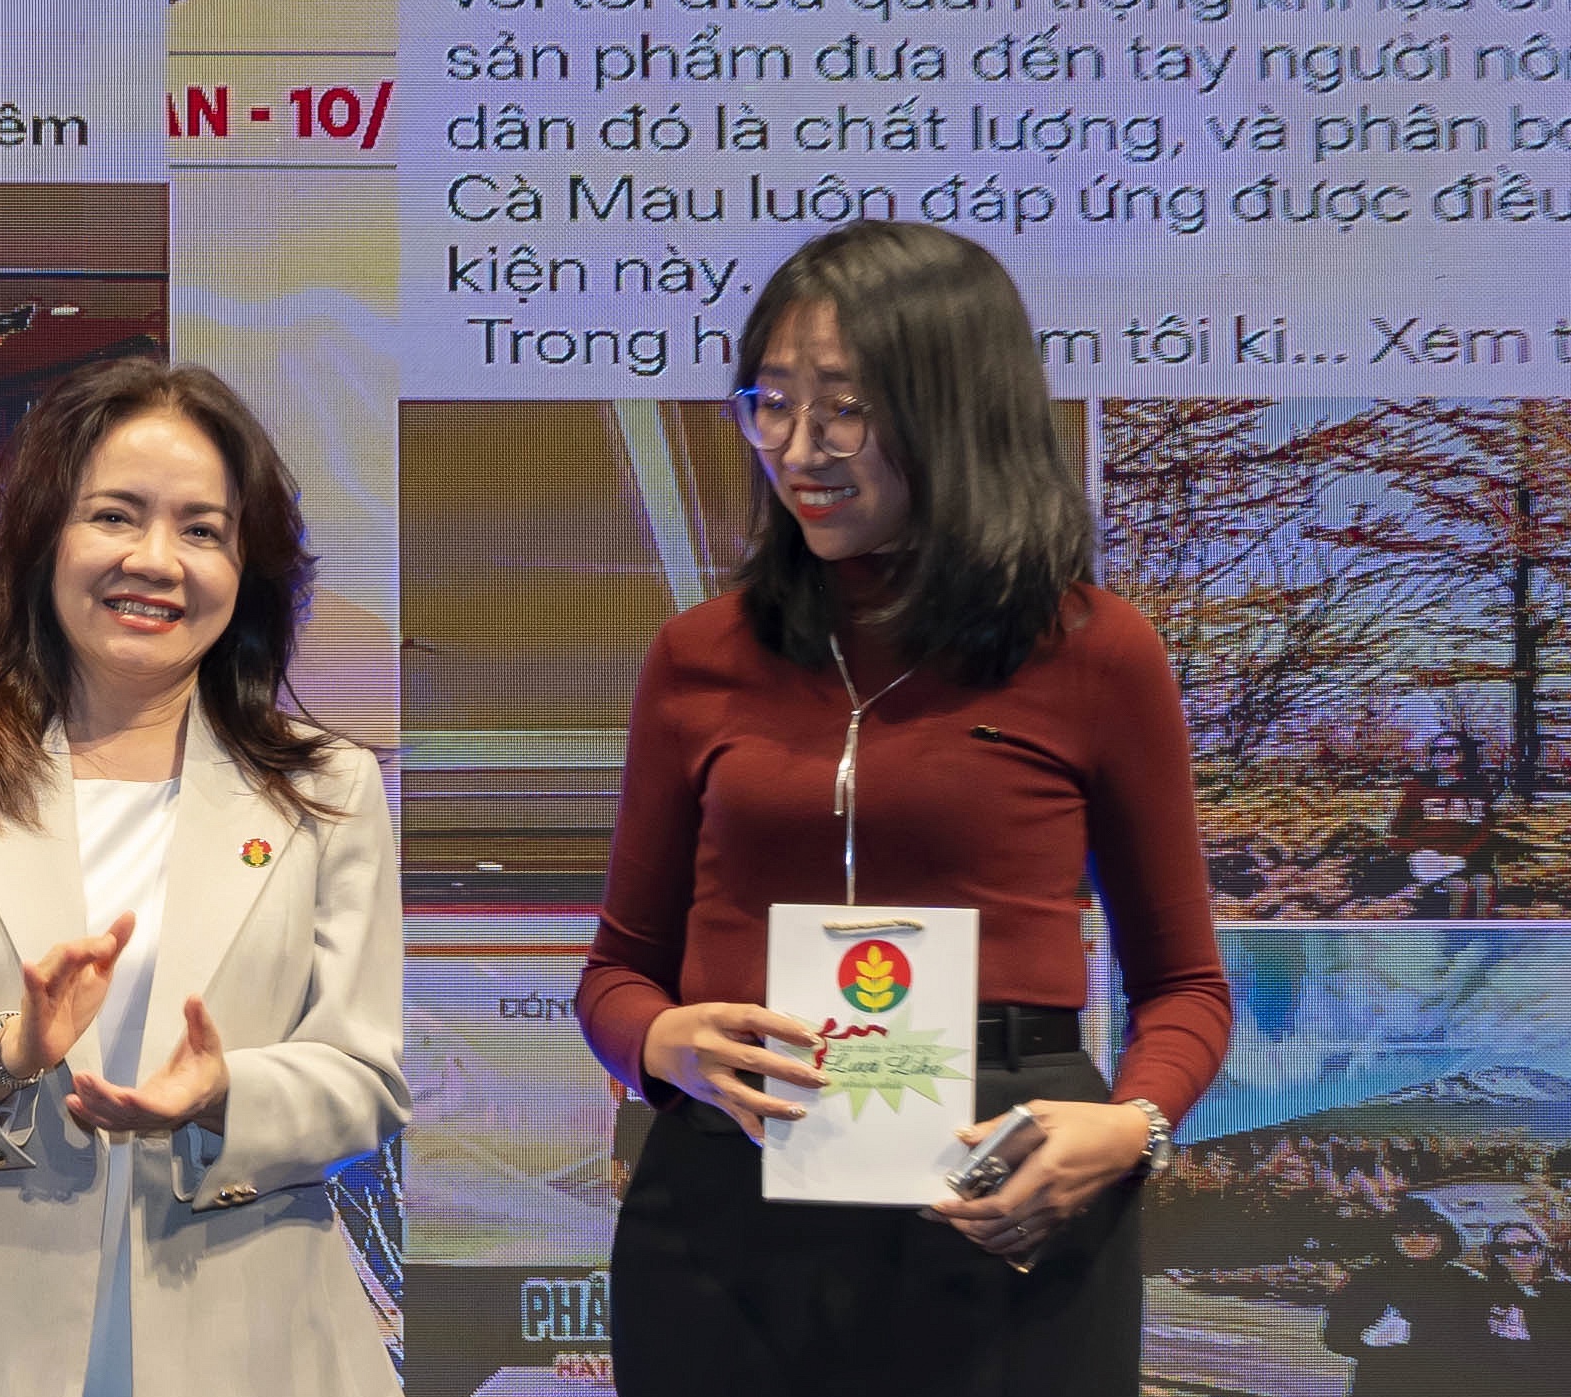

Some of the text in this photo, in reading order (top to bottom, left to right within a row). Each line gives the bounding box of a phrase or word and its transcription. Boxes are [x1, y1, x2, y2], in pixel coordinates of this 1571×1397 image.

[445, 30, 569, 82] sản
[594, 24, 792, 90] phẩm
[814, 32, 948, 83] đưa
[972, 24, 1105, 83] đến
[1130, 38, 1237, 93] tay
[1258, 31, 1453, 93] người
[445, 104, 576, 152] dân
[599, 103, 691, 152] đó
[716, 103, 770, 152] là
[794, 95, 948, 153] chất
[971, 104, 1184, 162] lượng,
[1205, 106, 1288, 153] và
[1314, 103, 1489, 162] phân
[446, 173, 544, 223] Cà
[569, 174, 724, 223] Mau
[750, 172, 897, 223] luôn
[920, 173, 1058, 234] đáp
[1080, 176, 1207, 235] ứng
[1231, 176, 1412, 232] được
[446, 245, 753, 304] kiện này.
[466, 317, 669, 377] Trong
[1122, 313, 1211, 365] tôi
[1369, 316, 1530, 365] Xem
